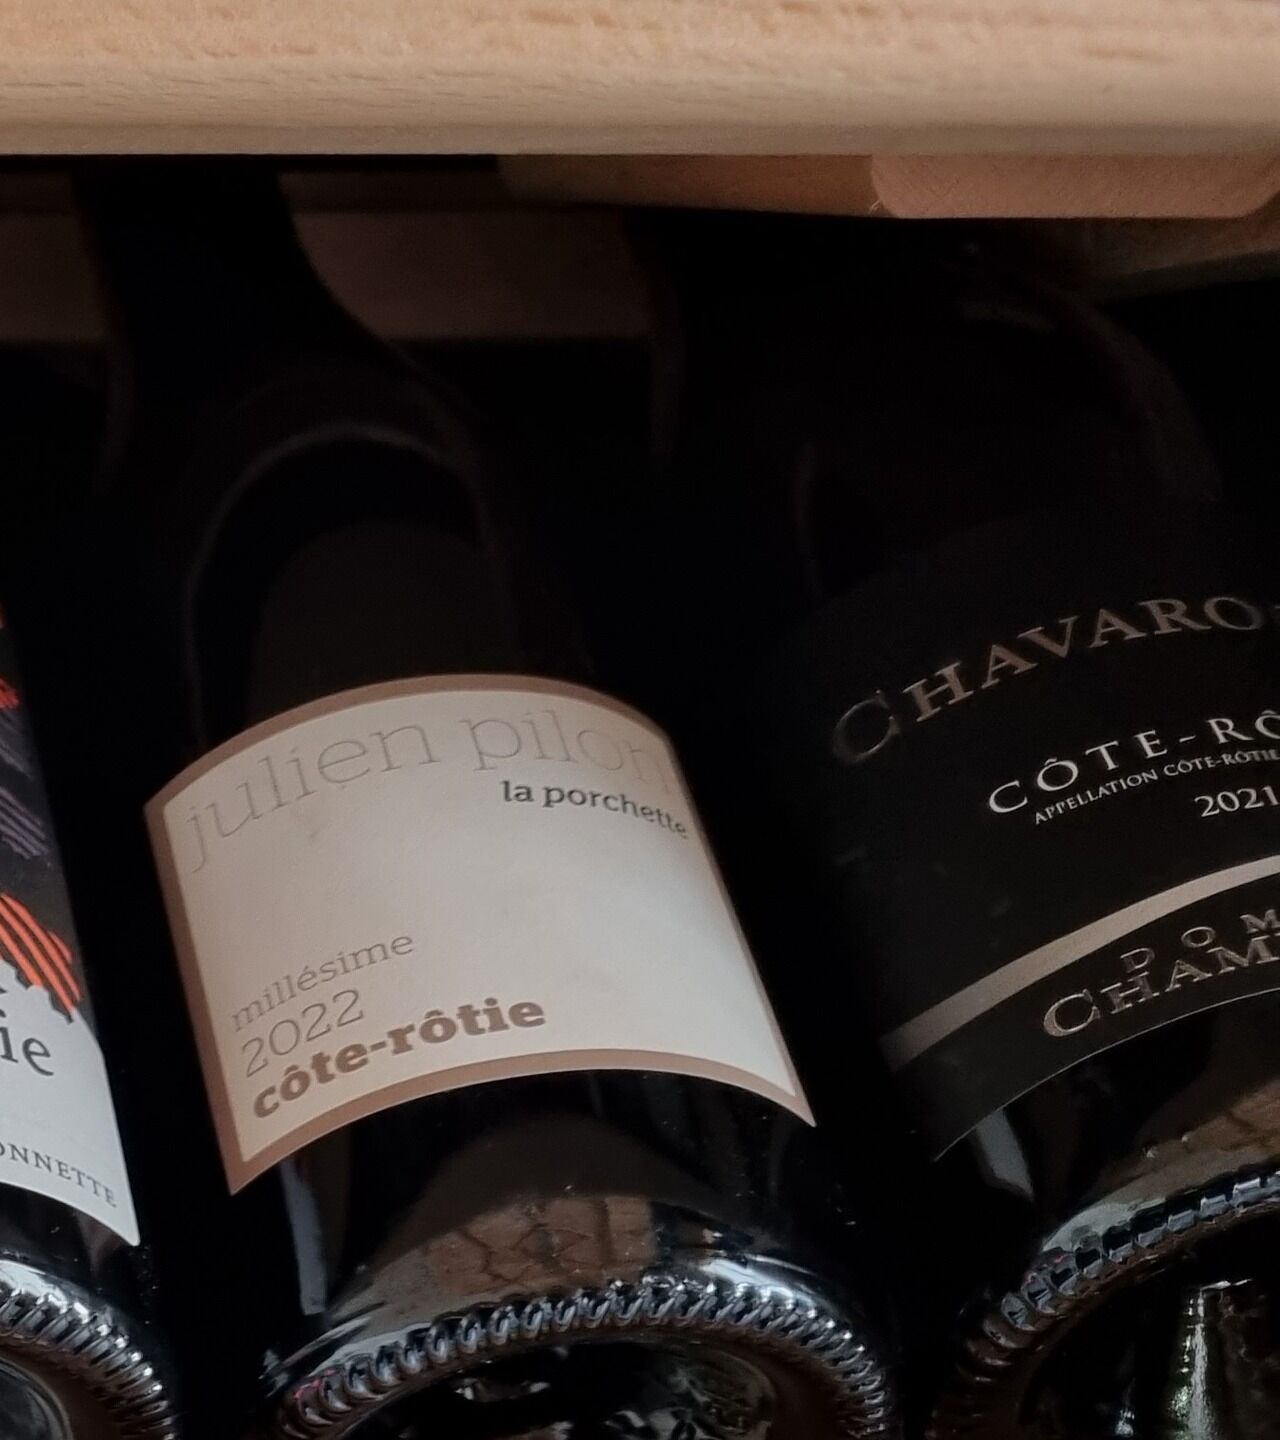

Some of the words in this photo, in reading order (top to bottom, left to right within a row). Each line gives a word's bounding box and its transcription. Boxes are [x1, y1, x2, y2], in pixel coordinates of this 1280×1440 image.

[833, 596, 1280, 765] CHAVARO
[183, 716, 442, 873] julien
[501, 779, 534, 803] la
[542, 783, 689, 840] porchette
[1035, 768, 1159, 825] APPELLATION
[1194, 785, 1280, 817] 2021
[230, 932, 414, 1034] millésime
[242, 987, 365, 1079] 2022
[253, 996, 547, 1119] côte-rôtie
